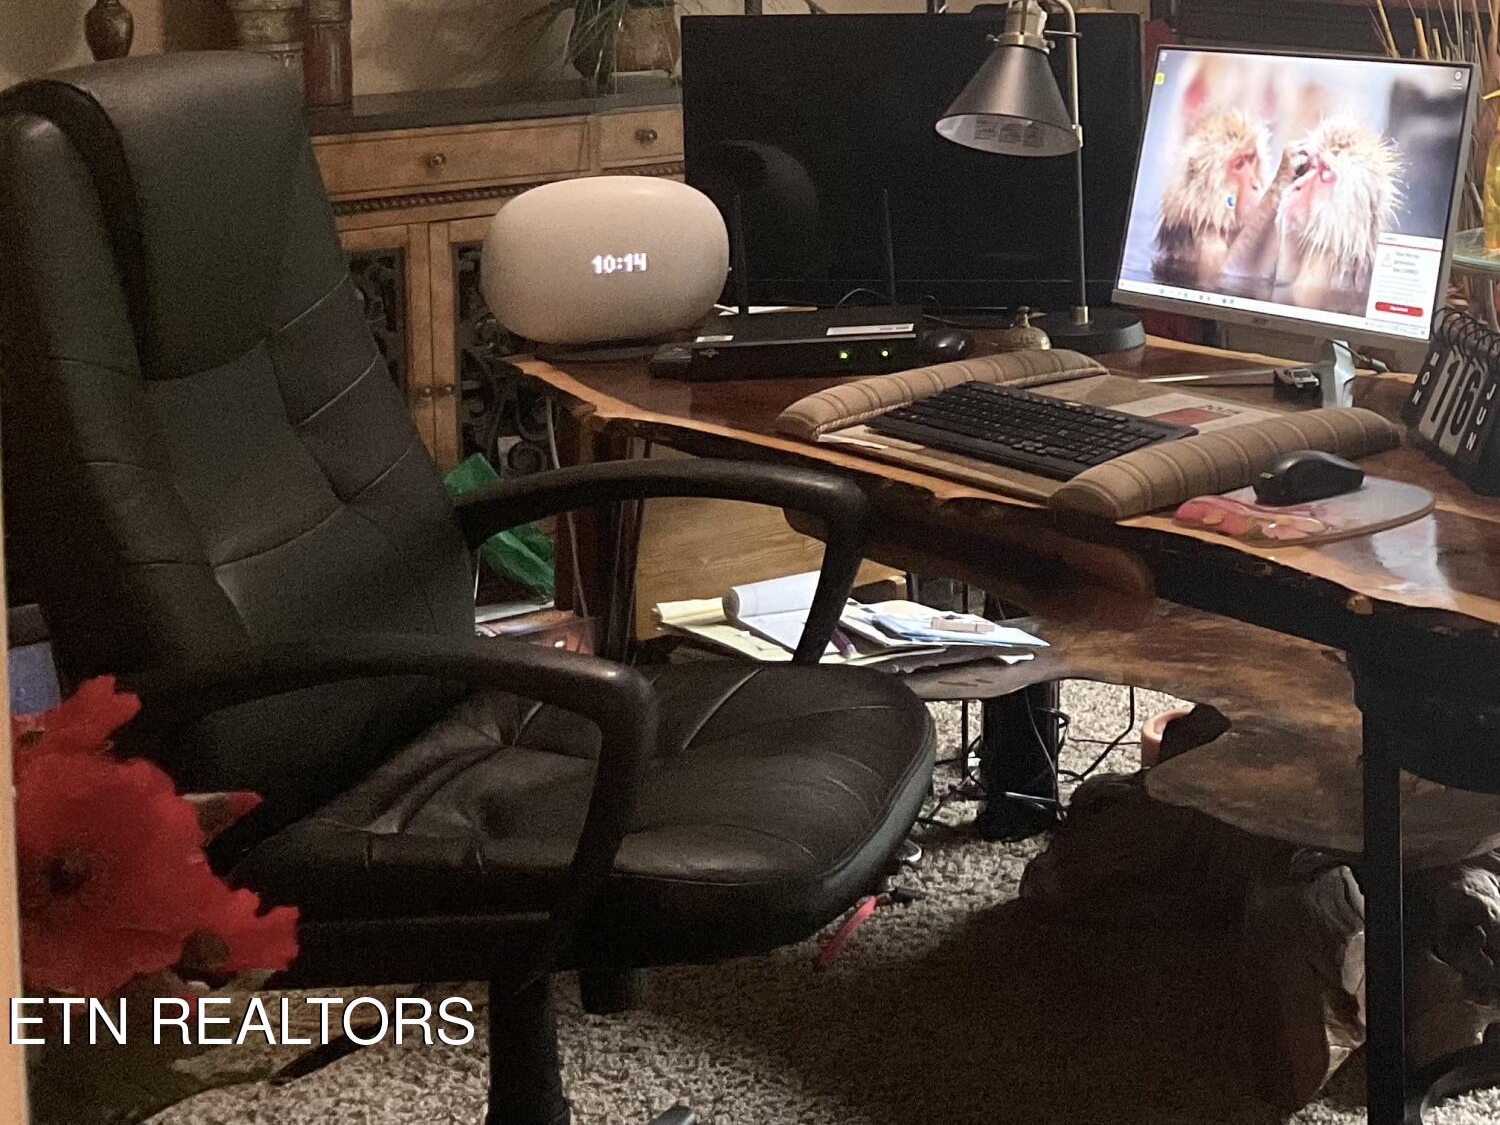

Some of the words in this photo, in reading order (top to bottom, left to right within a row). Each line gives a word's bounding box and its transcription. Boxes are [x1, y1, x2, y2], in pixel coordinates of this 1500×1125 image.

[591, 252, 647, 274] 10:14
[1412, 352, 1440, 405] MON
[1429, 360, 1481, 436] 16
[1465, 383, 1497, 451] JUN
